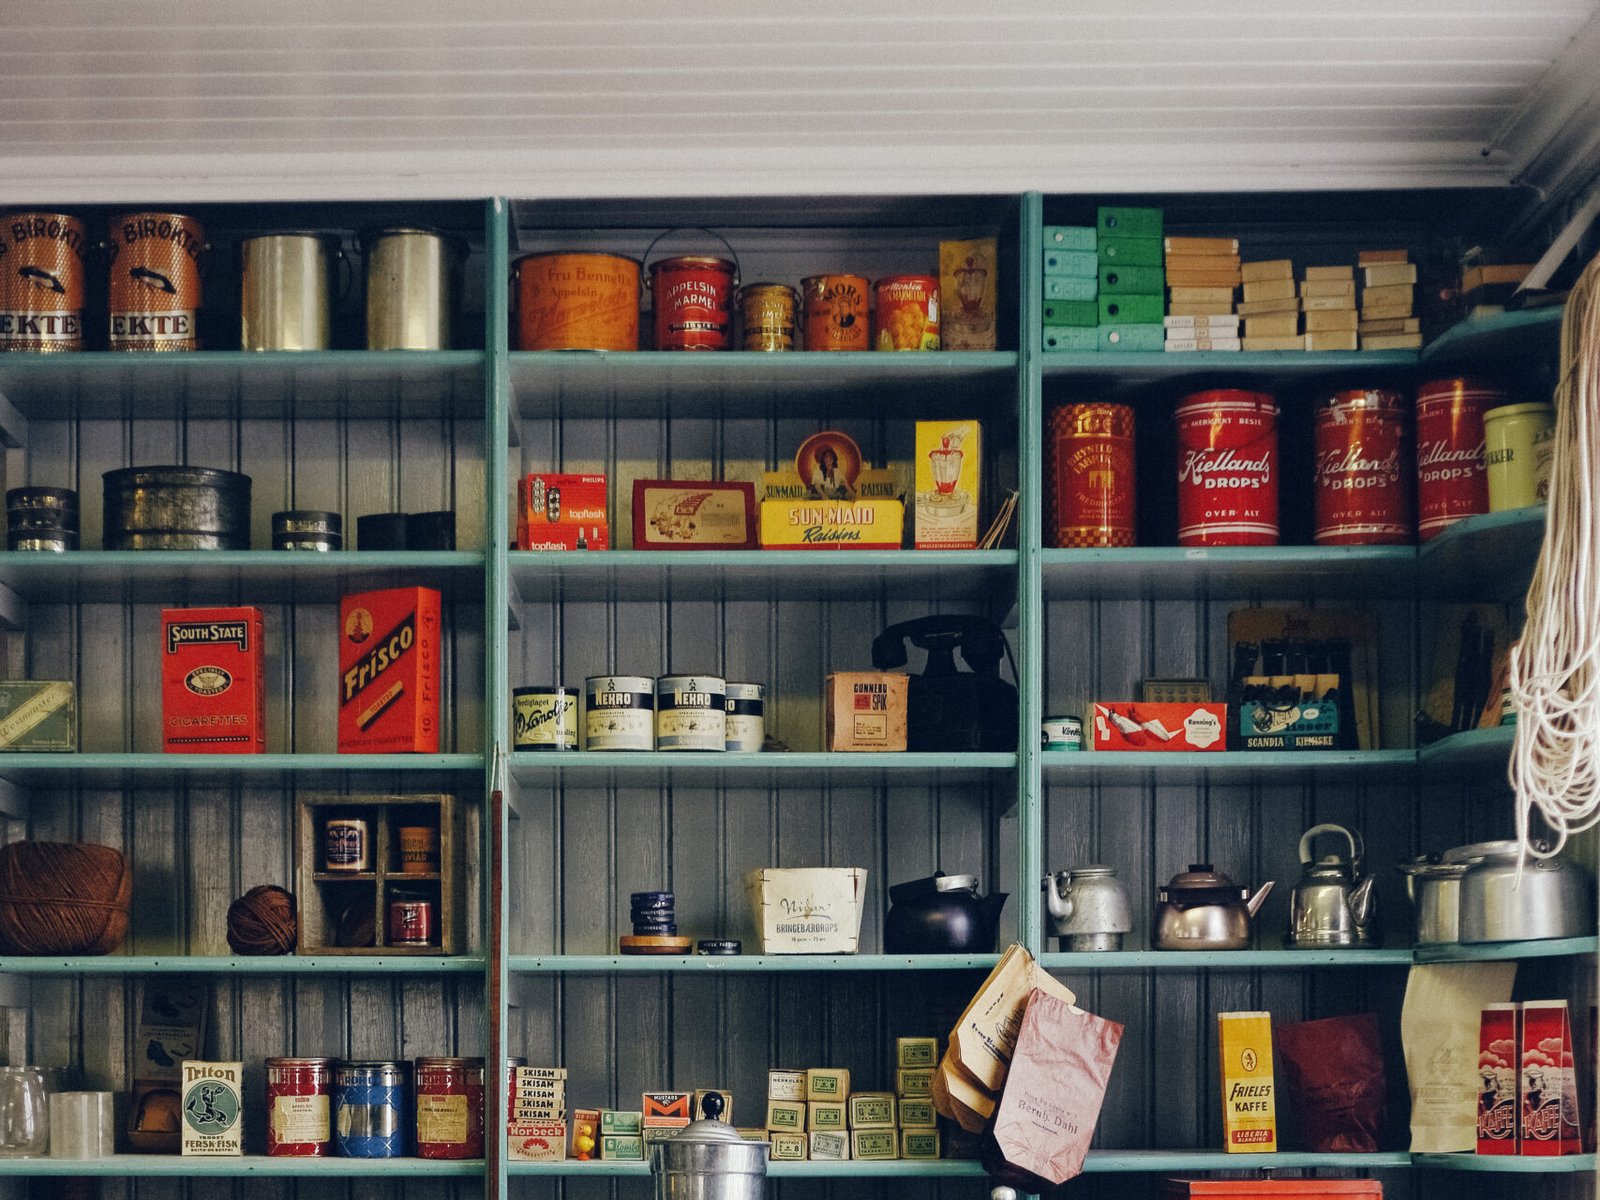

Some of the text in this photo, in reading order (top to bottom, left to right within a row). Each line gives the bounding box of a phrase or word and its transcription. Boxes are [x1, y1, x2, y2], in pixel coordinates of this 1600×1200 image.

[112, 314, 189, 335] EKTE
[1423, 467, 1473, 483] DROPS
[861, 483, 894, 497] RAISINS
[1205, 478, 1260, 489] DROPS
[1332, 476, 1388, 490] DROPS
[568, 508, 604, 519] topflash
[1205, 509, 1260, 518] OVER ALT
[1332, 510, 1362, 519] OVER
[802, 526, 862, 543] Raisins
[531, 541, 567, 550] topflash
[172, 625, 244, 642] SOUTH STATE
[344, 625, 413, 700] Frisco
[421, 639, 432, 703] Frisco
[595, 687, 632, 707] NEKRO
[674, 687, 712, 706] NEKRO
[872, 694, 888, 711] SPIK
[170, 714, 248, 727] CIGARETTES
[1247, 736, 1285, 748] SCANDIA
[184, 1066, 236, 1083] Triton
[523, 1068, 555, 1078] SKISAM
[521, 1079, 554, 1088] SKISAM
[522, 1089, 555, 1099] SKISAM
[1230, 1082, 1272, 1101] FRIELES
[521, 1099, 554, 1109] SKISAM
[1235, 1101, 1267, 1112] KAFFE
[518, 1109, 551, 1118] SKISAM
[1053, 1115, 1078, 1135] Dahl
[1478, 1104, 1514, 1140] KAFFE
[1524, 1104, 1560, 1141] KAFFE
[510, 1127, 562, 1137] Norbeck
[1236, 1129, 1269, 1137] LIBERIA
